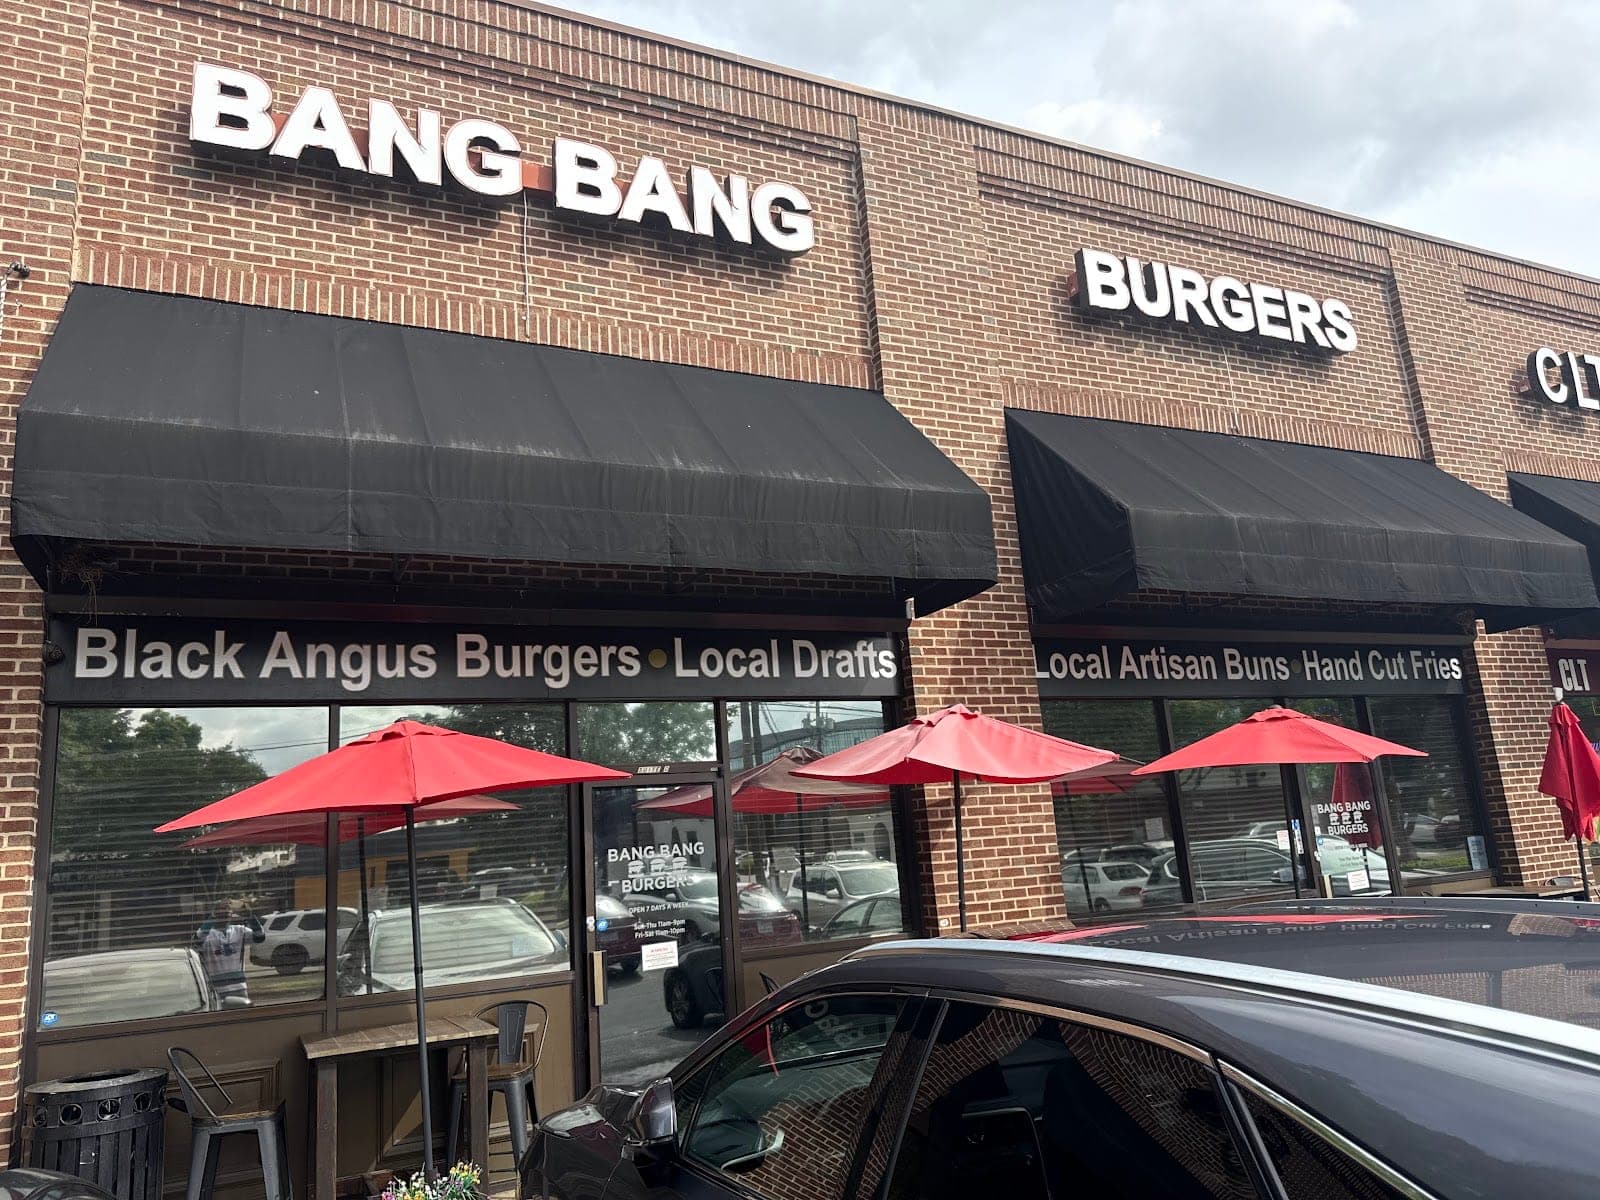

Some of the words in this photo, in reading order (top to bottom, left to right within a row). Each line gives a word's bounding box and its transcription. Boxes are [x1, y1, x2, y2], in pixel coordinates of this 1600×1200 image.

[189, 61, 524, 196] BANG
[555, 136, 814, 252] BANG
[1079, 248, 1358, 352] BURGERS
[75, 627, 245, 680] Black
[259, 631, 438, 692] Angus
[456, 633, 641, 689] Burgers
[673, 637, 780, 679] Local
[793, 638, 898, 680] Drafts
[1032, 644, 1111, 680] Local
[1119, 645, 1218, 680] Artisan
[1223, 648, 1290, 681] Buns
[1302, 650, 1364, 681] Hand
[1368, 650, 1406, 681] Cut
[1410, 650, 1463, 680] Fries
[1558, 658, 1591, 691] CLT
[1317, 802, 1344, 814] BANG
[1345, 801, 1371, 811] BANG
[1327, 823, 1369, 836] BURGERS
[607, 845, 655, 863] BANG
[660, 841, 705, 857] BANG
[621, 874, 694, 893] BURGERS
[650, 903, 666, 911] DAYS
